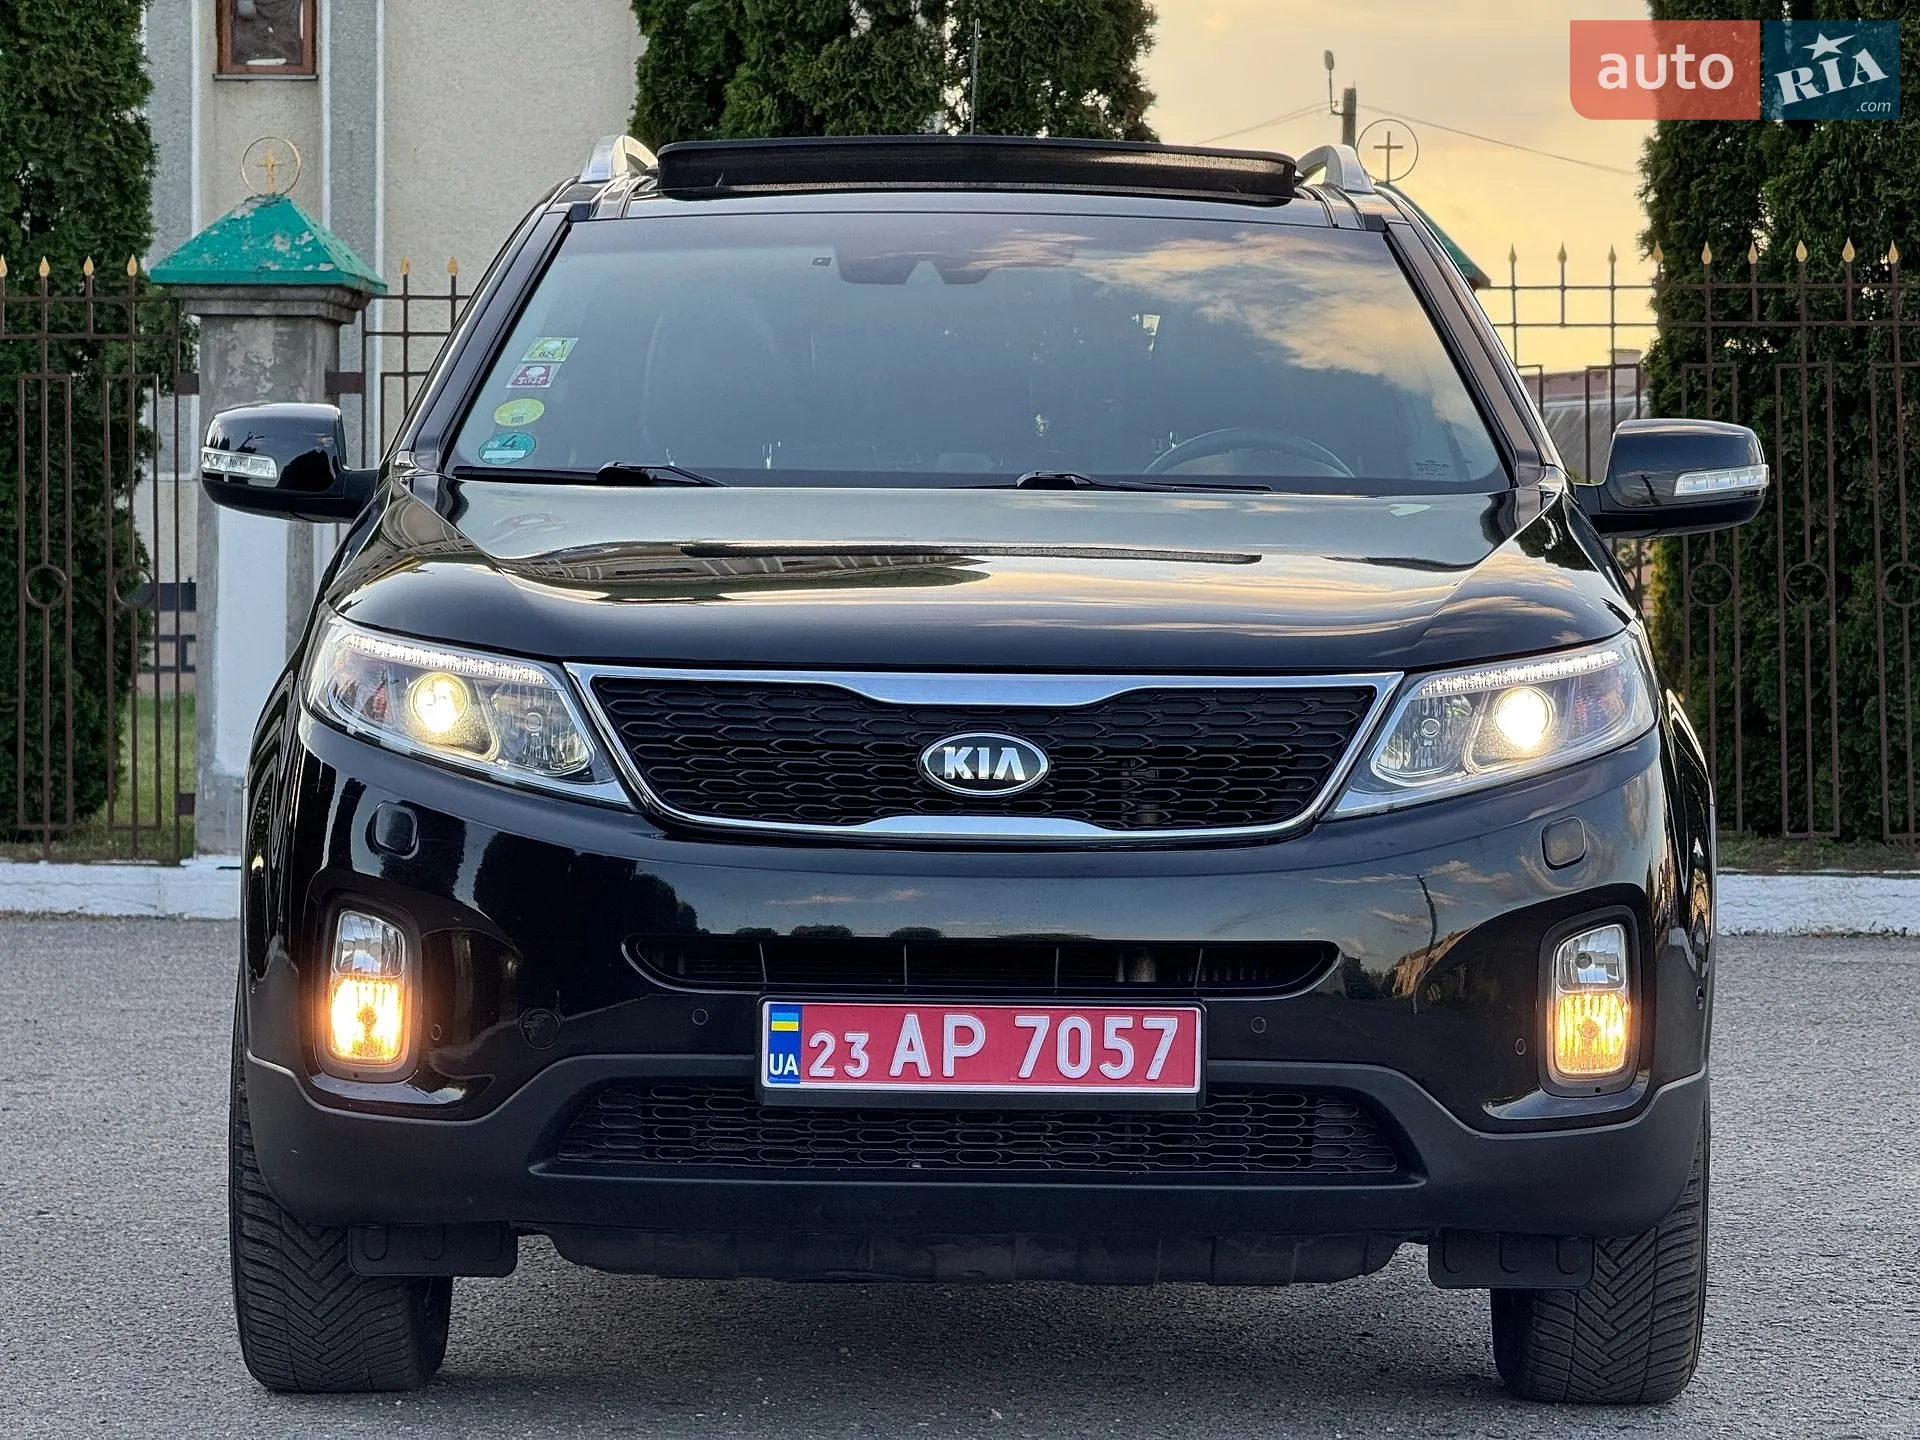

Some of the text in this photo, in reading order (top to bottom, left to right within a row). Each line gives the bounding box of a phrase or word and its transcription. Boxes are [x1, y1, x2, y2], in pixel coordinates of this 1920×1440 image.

[501, 434, 517, 449] 4
[943, 746, 1026, 781] KIA
[808, 1013, 1179, 1080] 23 AP 7057
[769, 1053, 800, 1076] UA
